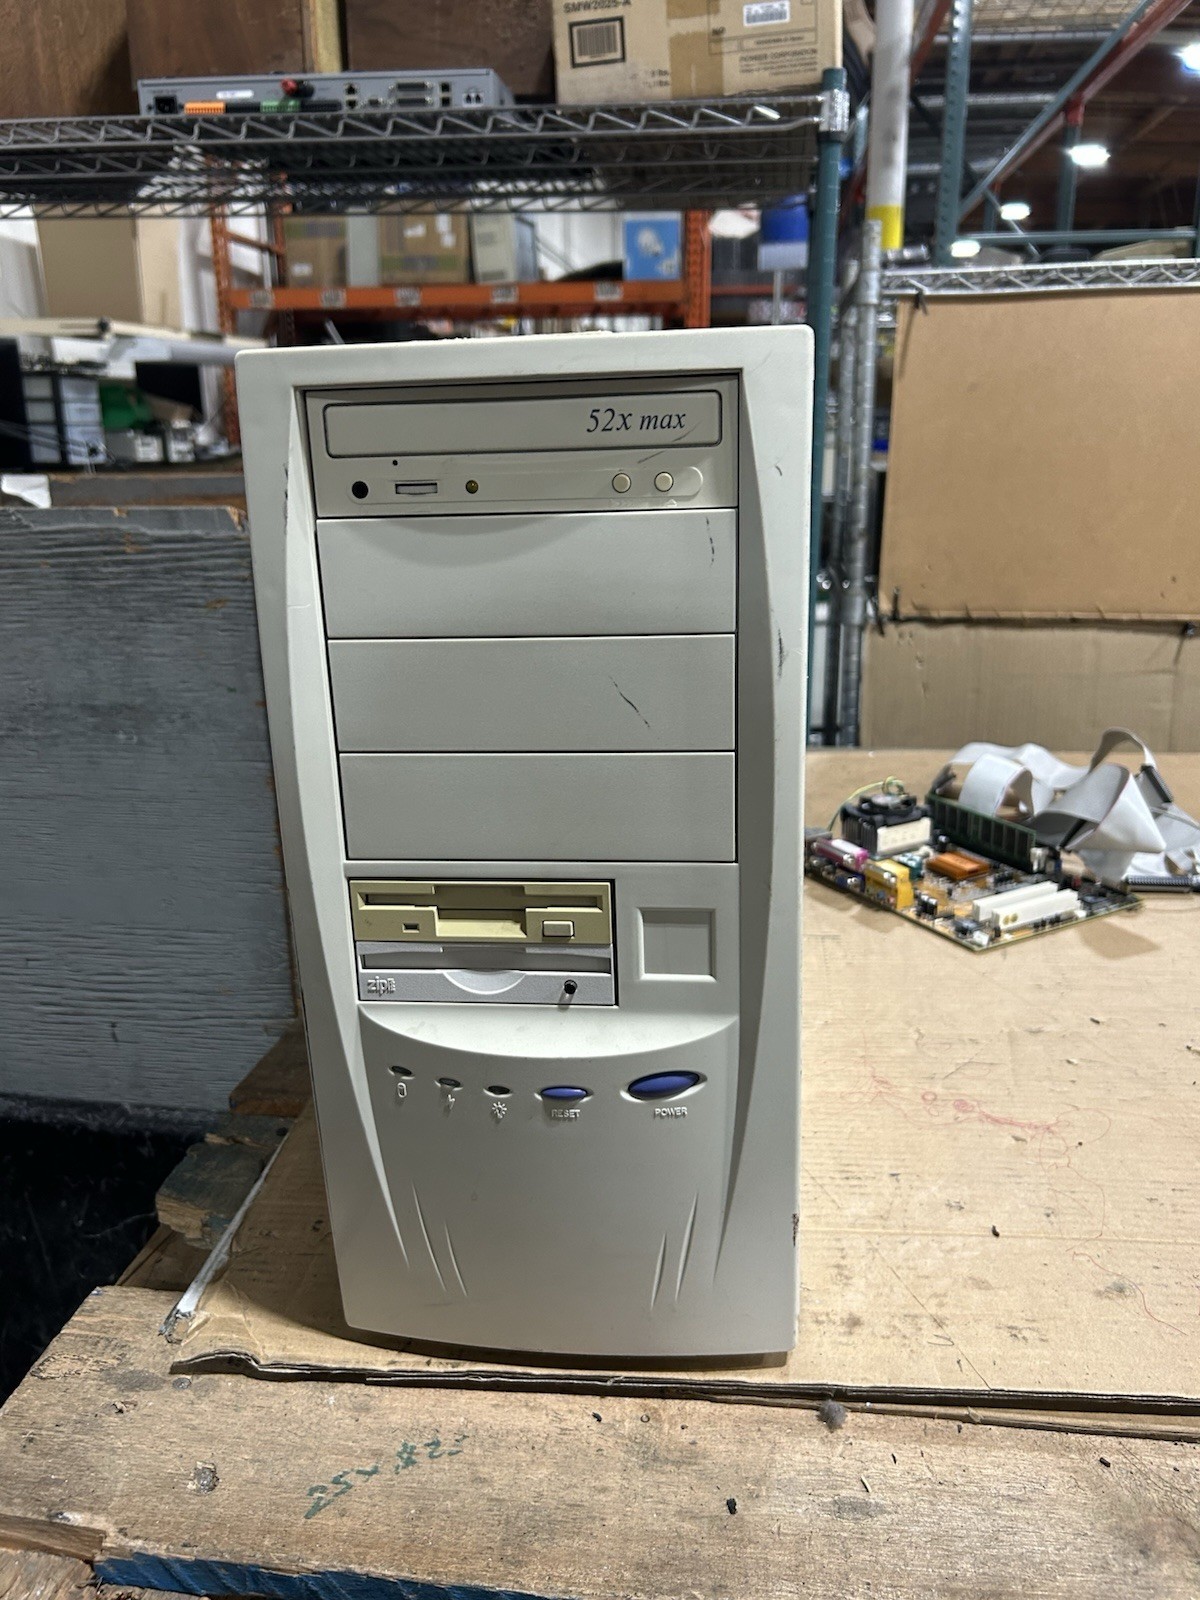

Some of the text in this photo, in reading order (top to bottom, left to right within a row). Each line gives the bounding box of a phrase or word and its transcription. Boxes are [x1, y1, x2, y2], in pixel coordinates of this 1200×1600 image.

[586, 408, 686, 433] 52x max
[551, 1109, 581, 1119] RESET
[654, 1107, 688, 1118] POWER
